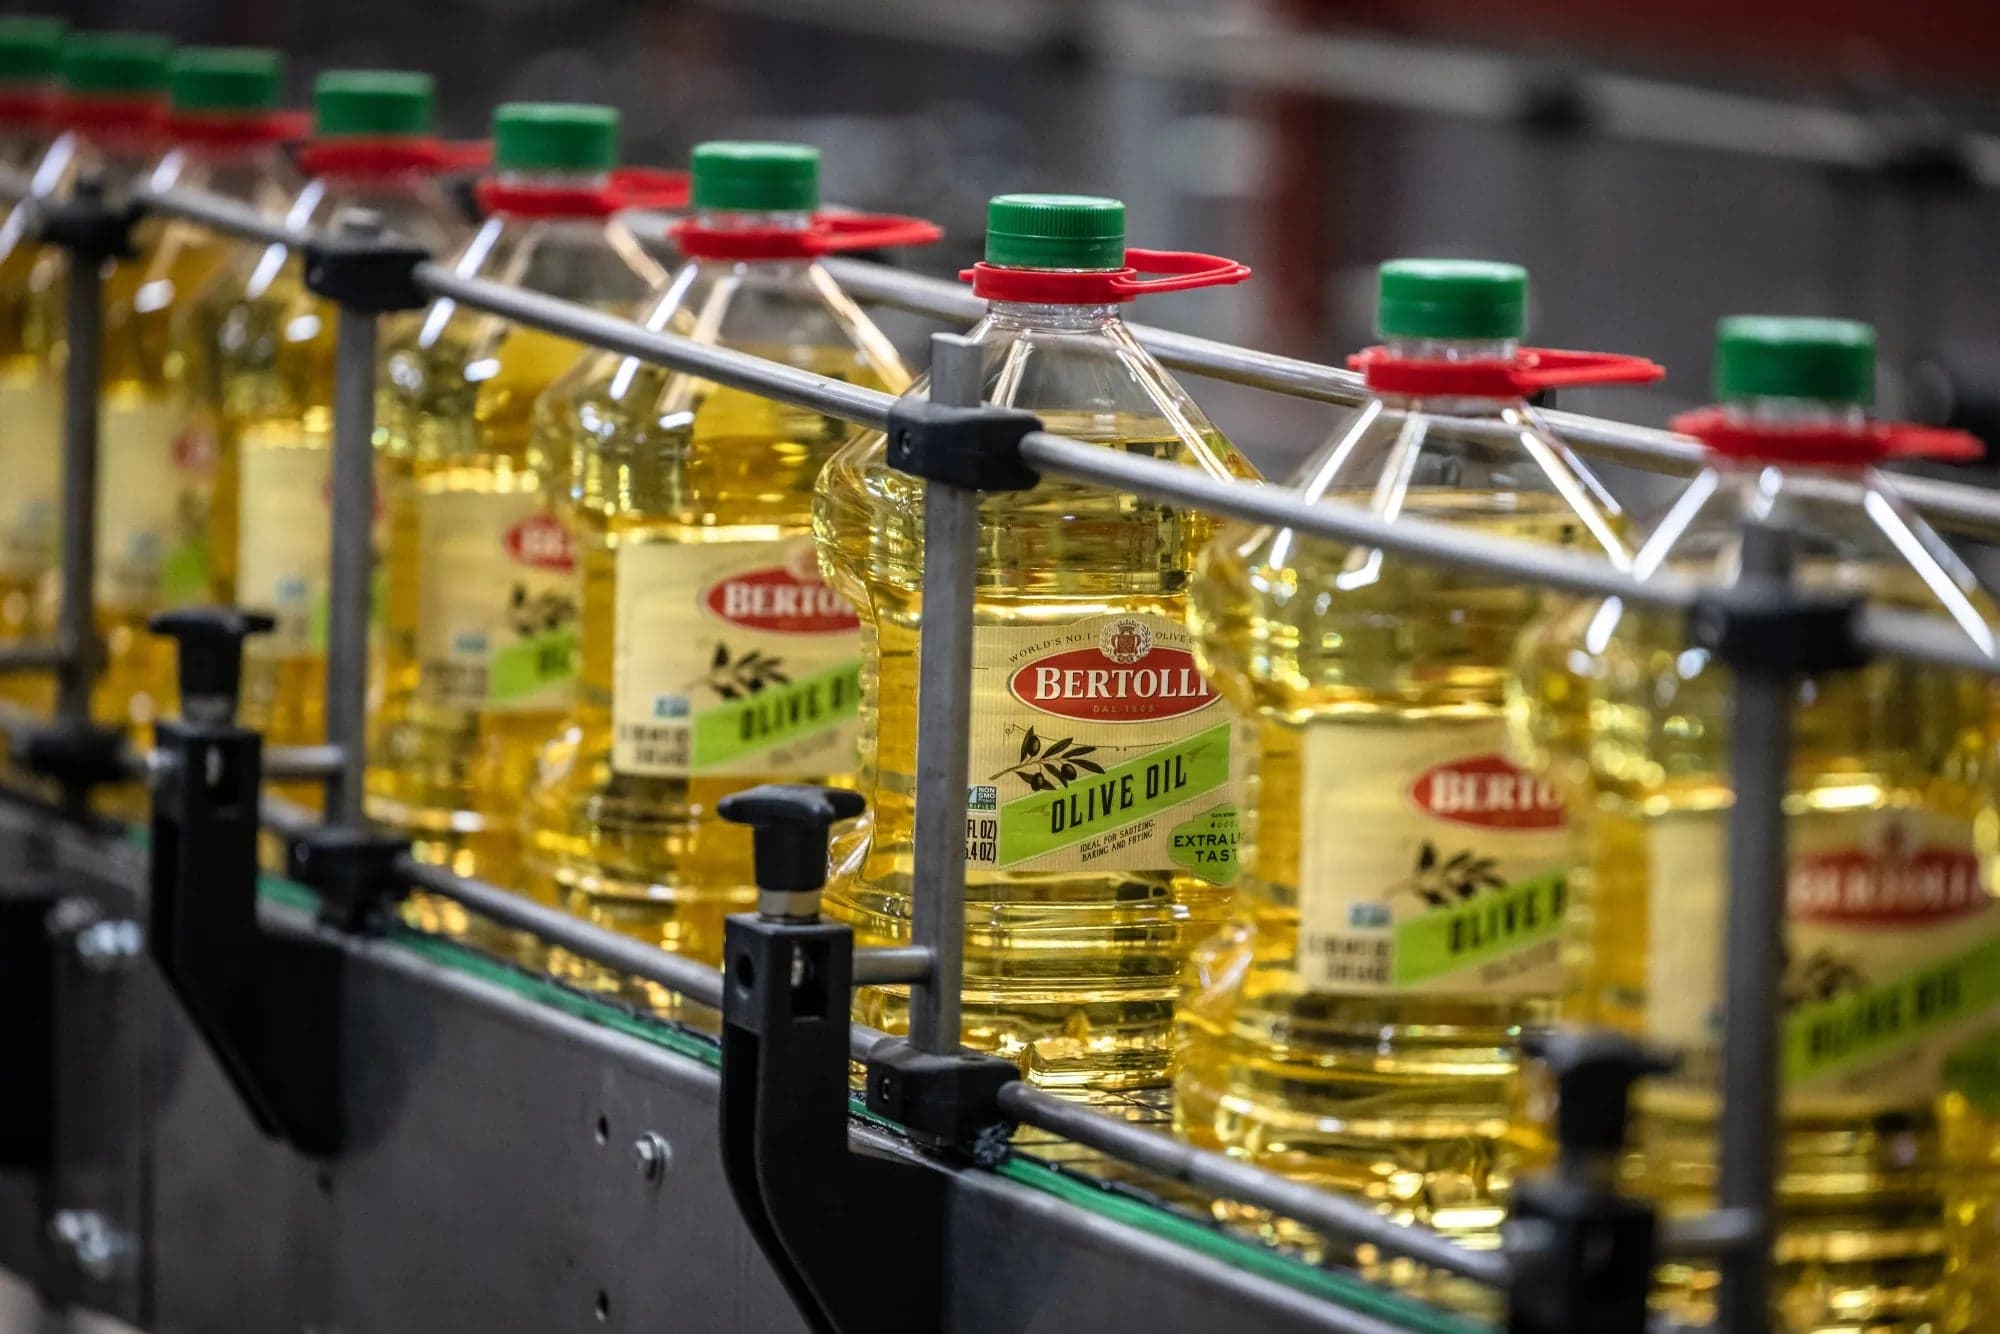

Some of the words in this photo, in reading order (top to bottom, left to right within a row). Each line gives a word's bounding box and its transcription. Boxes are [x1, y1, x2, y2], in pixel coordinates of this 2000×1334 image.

[724, 582, 853, 618] BERTO
[1008, 637, 1062, 664] WORLD'S
[1155, 631, 1187, 643] OLIVE
[1035, 666, 1209, 701] BERTOLLI
[1093, 704, 1116, 713] DAL
[1051, 773, 1134, 834] OLIVE
[1146, 754, 1187, 801] OIL
[967, 819, 978, 839] FL
[980, 819, 997, 842] OZ)
[1174, 833, 1228, 848] EXTRA
[979, 841, 996, 864] OZ)
[1080, 839, 1101, 853] IDEAL
[1103, 833, 1117, 845] FOR
[1082, 846, 1109, 862] BAKING
[1111, 839, 1126, 852] AND
[1128, 829, 1153, 845] FRYING
[1196, 849, 1237, 863] TAST
